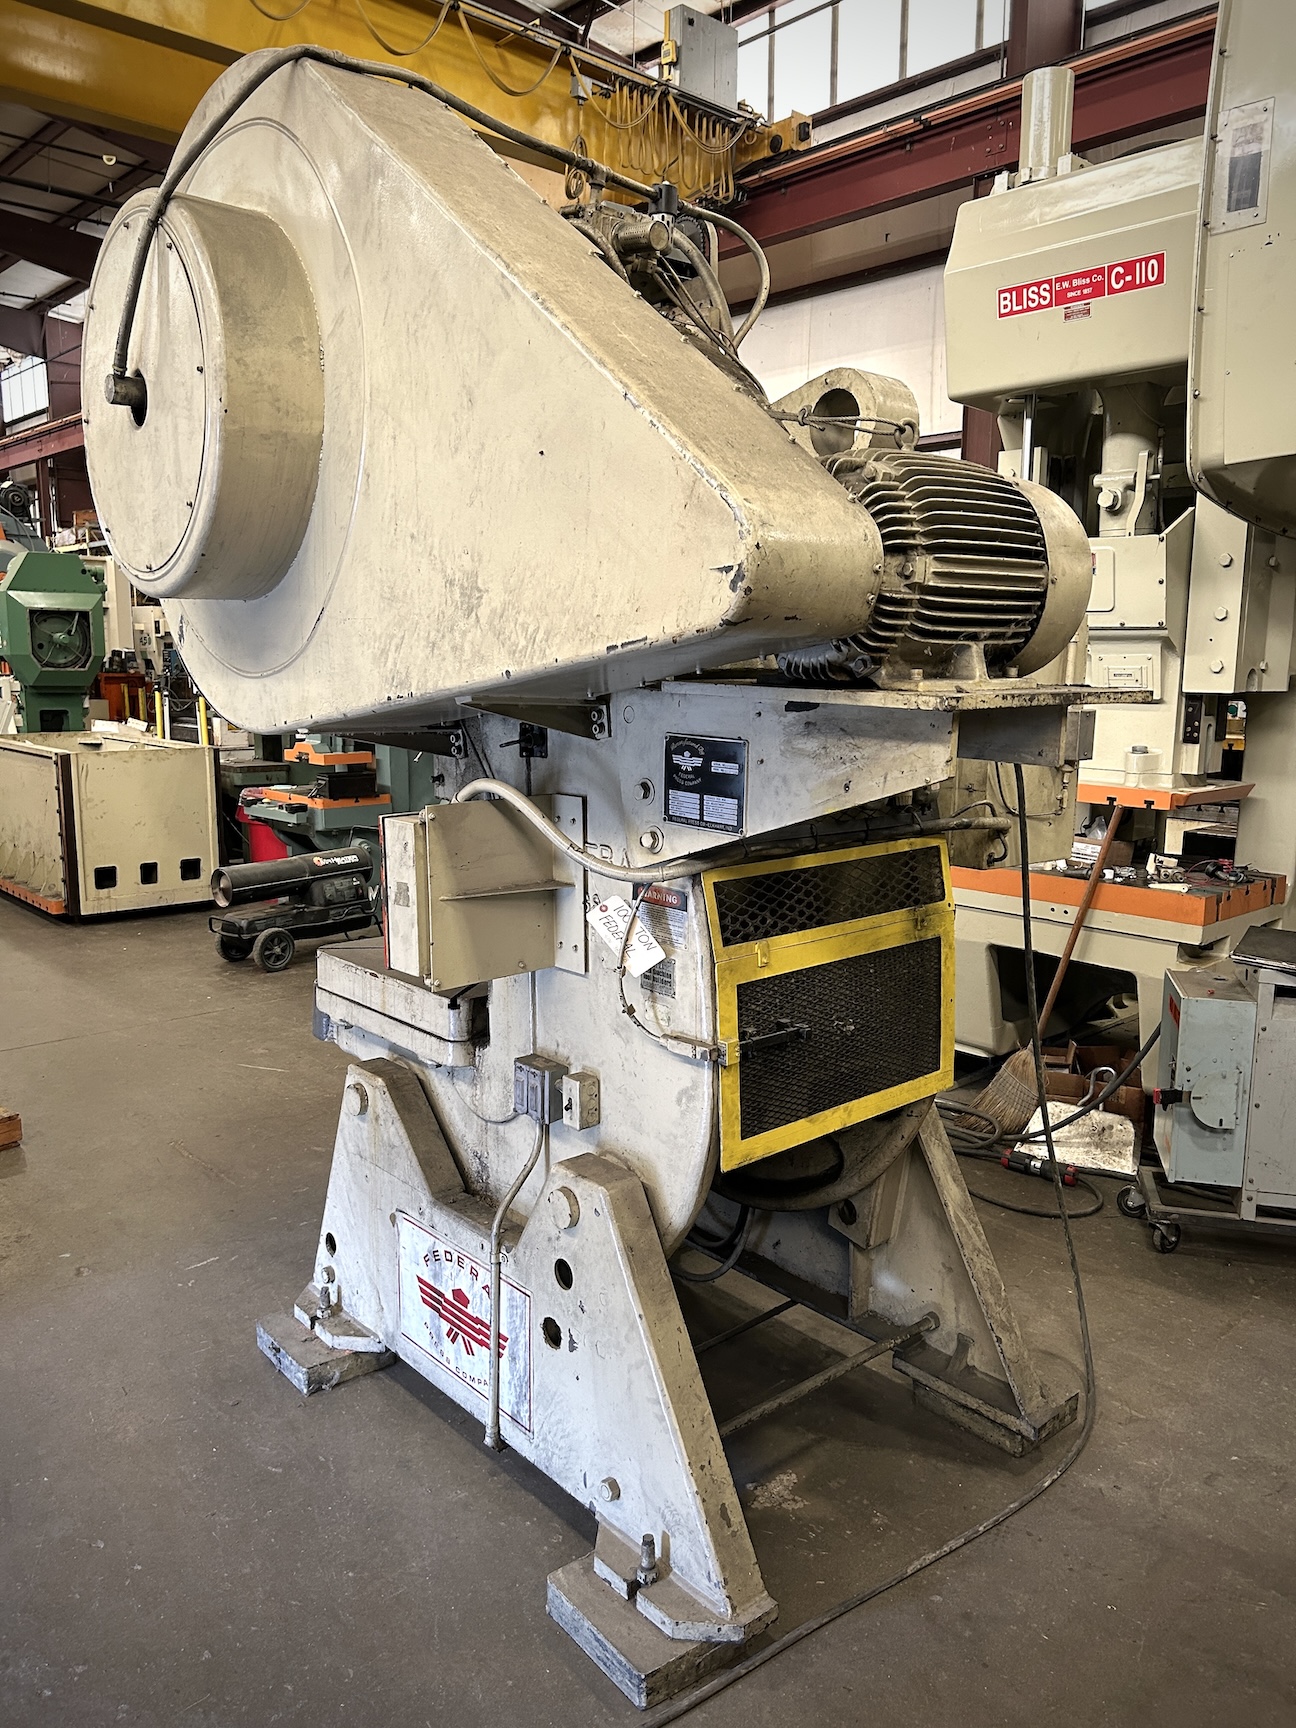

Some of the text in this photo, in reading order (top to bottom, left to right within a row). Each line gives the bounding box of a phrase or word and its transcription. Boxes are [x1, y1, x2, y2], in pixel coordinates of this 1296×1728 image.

[1055, 274, 1104, 290] E.W. Bliss Co.
[1110, 258, 1159, 290] C-110
[1000, 283, 1051, 315] BLISS
[1066, 289, 1082, 298] SINCE
[635, 926, 657, 951] TON
[423, 1250, 490, 1300] FEDERA
[455, 1366, 490, 1387] COMPA
